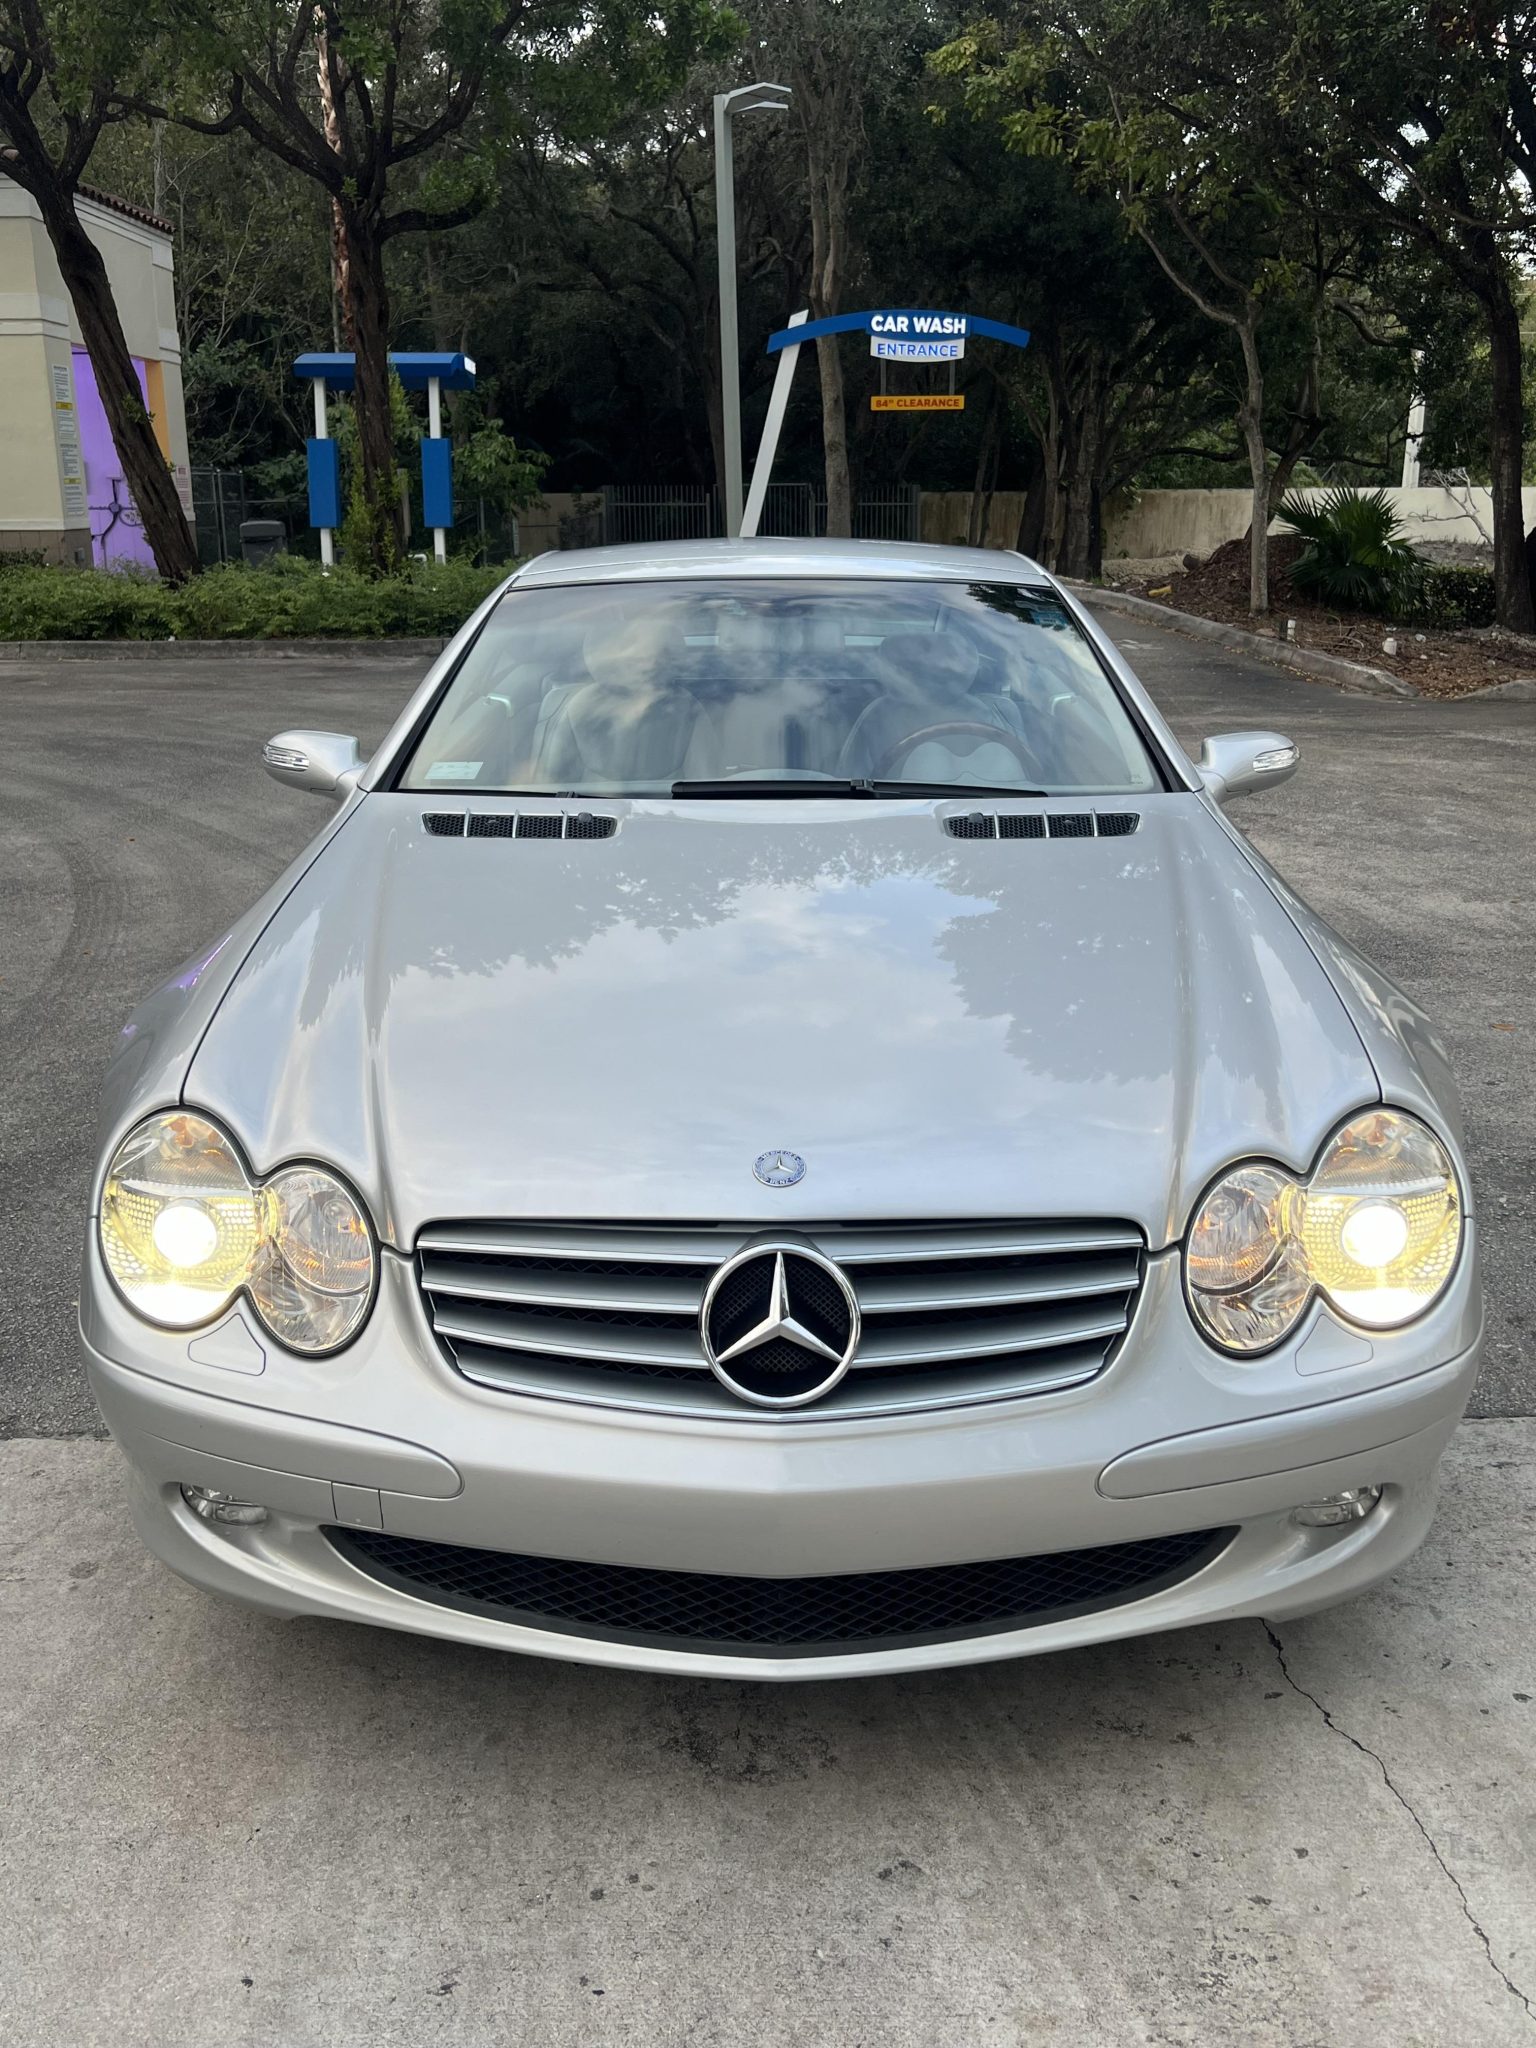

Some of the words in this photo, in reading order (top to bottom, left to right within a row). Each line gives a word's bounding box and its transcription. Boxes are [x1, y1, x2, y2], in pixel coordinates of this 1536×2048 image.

[871, 315, 909, 332] CAR
[913, 317, 966, 334] WASH
[877, 343, 958, 357] ENTRANCE
[896, 398, 960, 408] CLEARANCE
